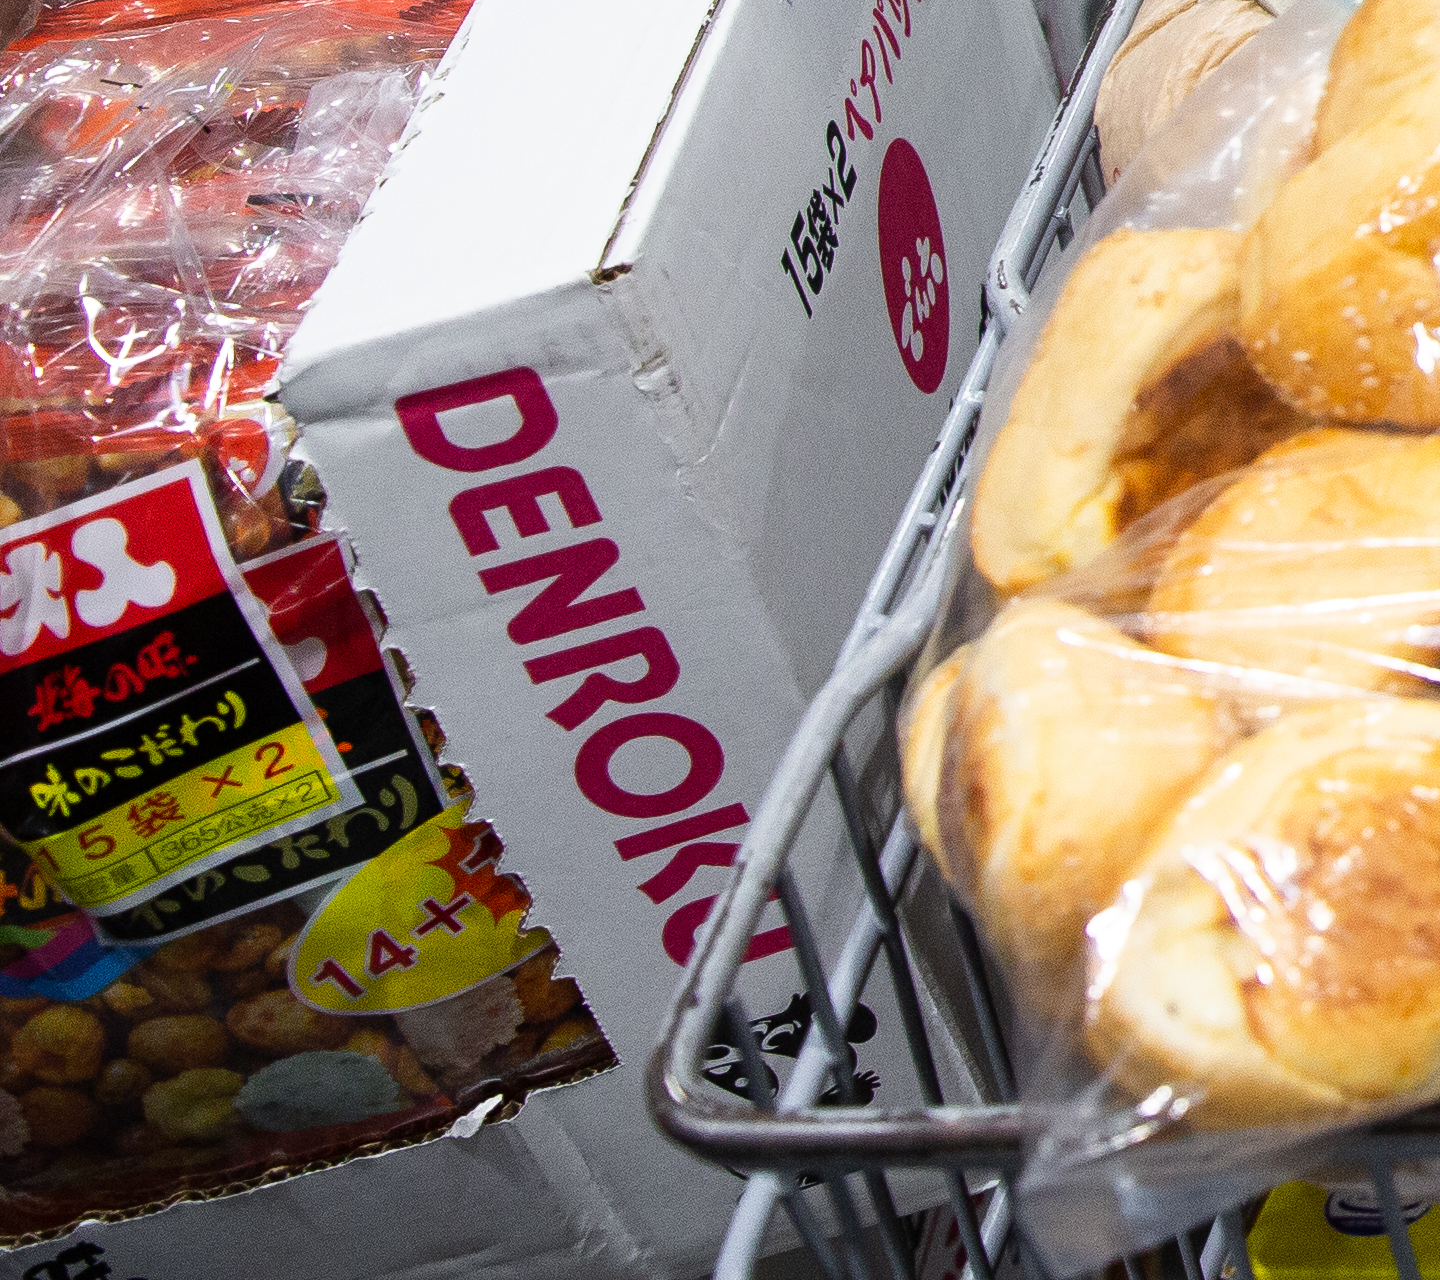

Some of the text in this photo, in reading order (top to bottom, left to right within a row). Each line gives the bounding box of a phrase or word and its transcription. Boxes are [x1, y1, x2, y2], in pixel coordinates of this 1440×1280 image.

[29, 690, 248, 817] 味のこだわり
[395, 365, 797, 969] DENROKU
